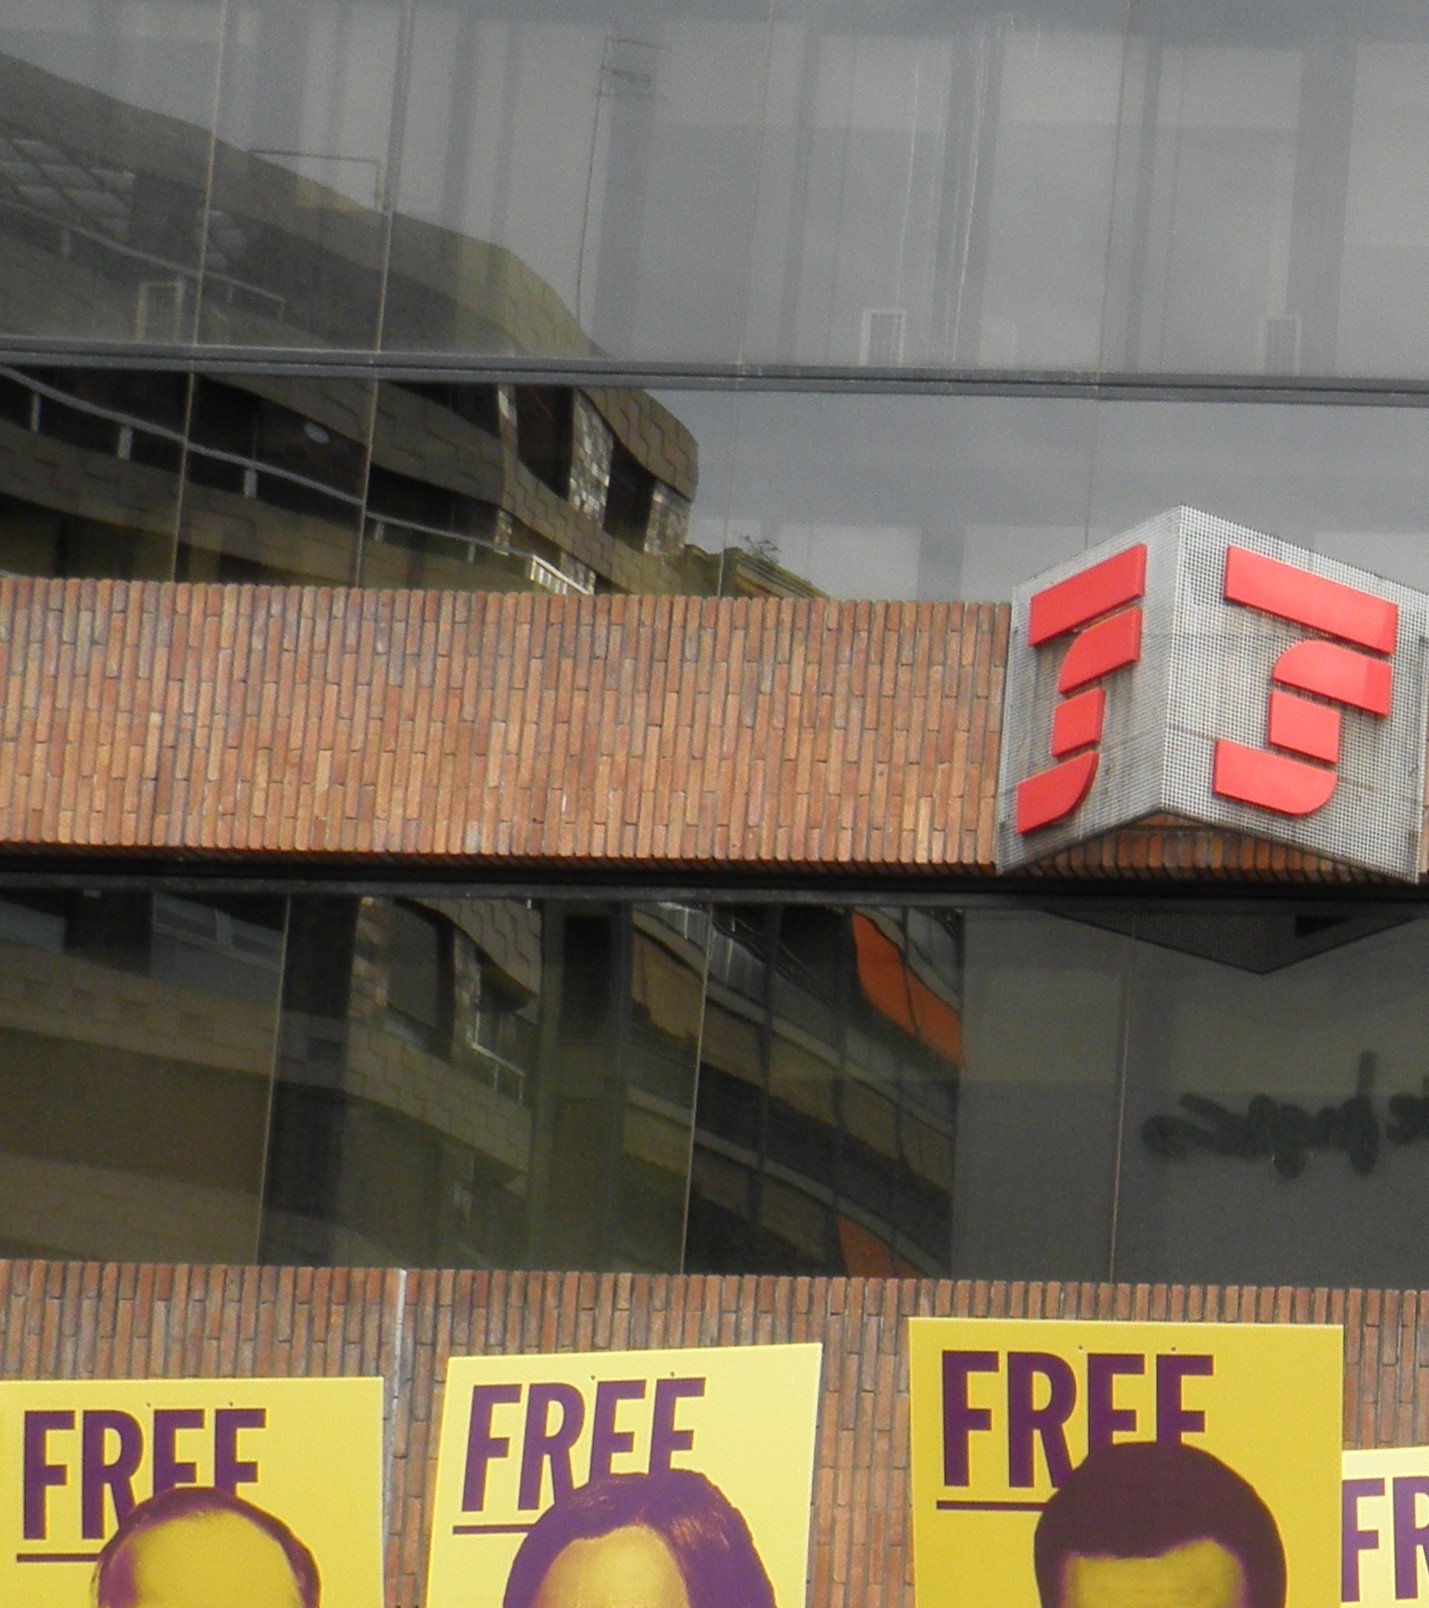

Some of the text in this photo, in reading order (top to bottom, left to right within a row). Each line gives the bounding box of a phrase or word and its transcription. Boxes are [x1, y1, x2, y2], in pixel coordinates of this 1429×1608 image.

[23, 1407, 266, 1541] FREE
[462, 1376, 706, 1512] FREE
[942, 1349, 1214, 1488] FREE
